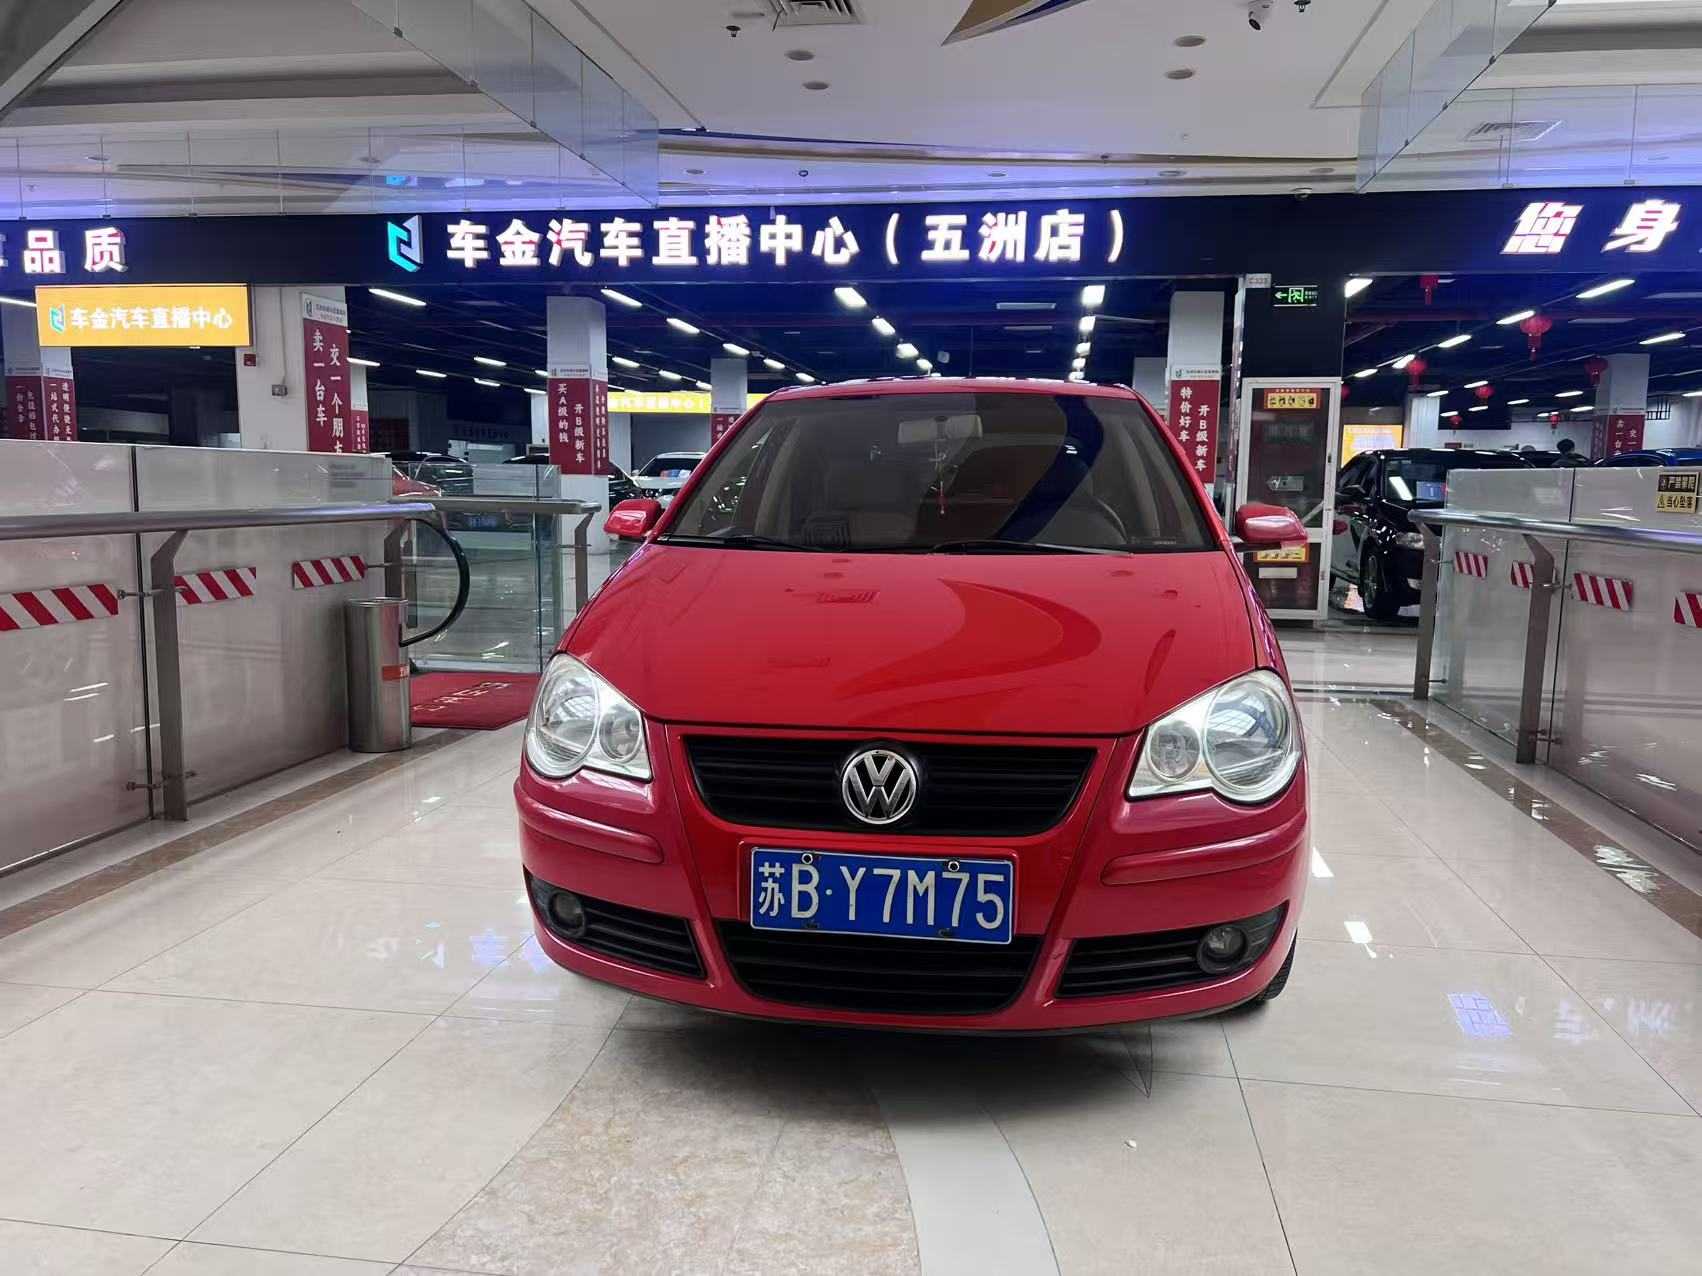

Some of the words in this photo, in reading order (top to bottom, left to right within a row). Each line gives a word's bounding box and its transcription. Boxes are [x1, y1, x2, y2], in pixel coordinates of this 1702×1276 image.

[0, 227, 127, 274] 品质
[71, 306, 233, 329] 车金汽车直播中心
[312, 329, 328, 427] 卖一台车
[574, 403, 584, 463] 开B级新车
[1179, 386, 1192, 442] 特价好车
[1195, 404, 1210, 471] 开B级新车
[758, 861, 1005, 930] 苏B·Y7M75
